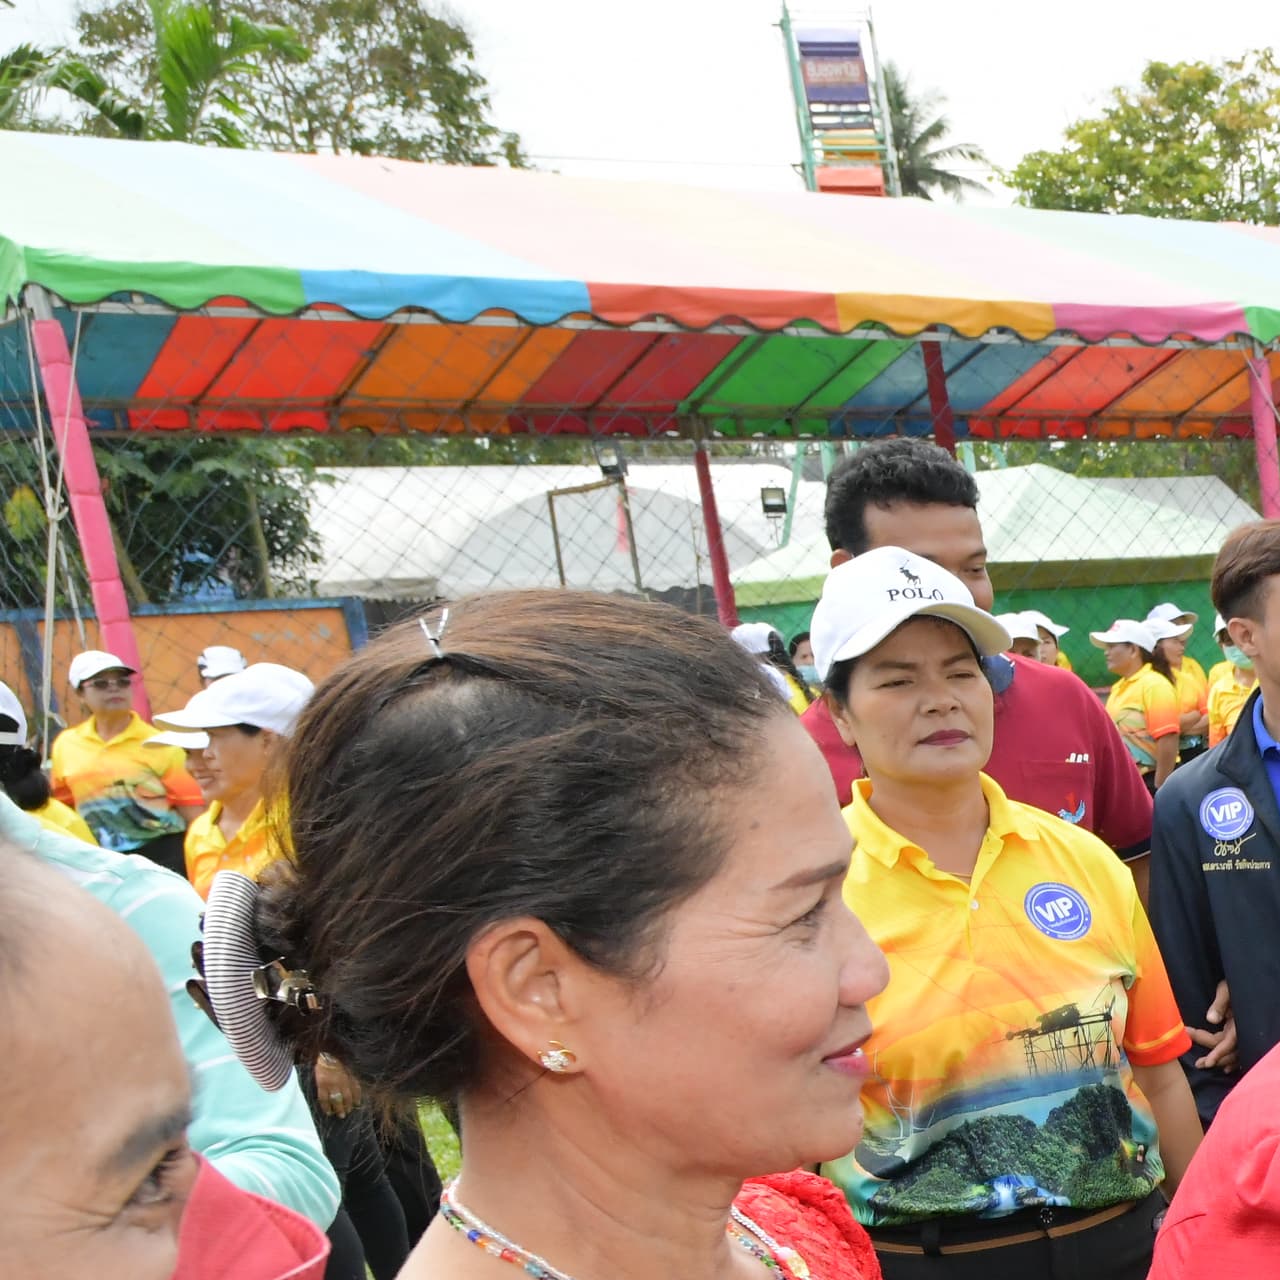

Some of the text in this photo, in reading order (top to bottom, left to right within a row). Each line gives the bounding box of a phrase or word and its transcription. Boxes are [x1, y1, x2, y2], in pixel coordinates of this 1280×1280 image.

[886, 587, 944, 601] POLO
[1209, 801, 1243, 823] VIP
[1034, 896, 1073, 922] VIP
